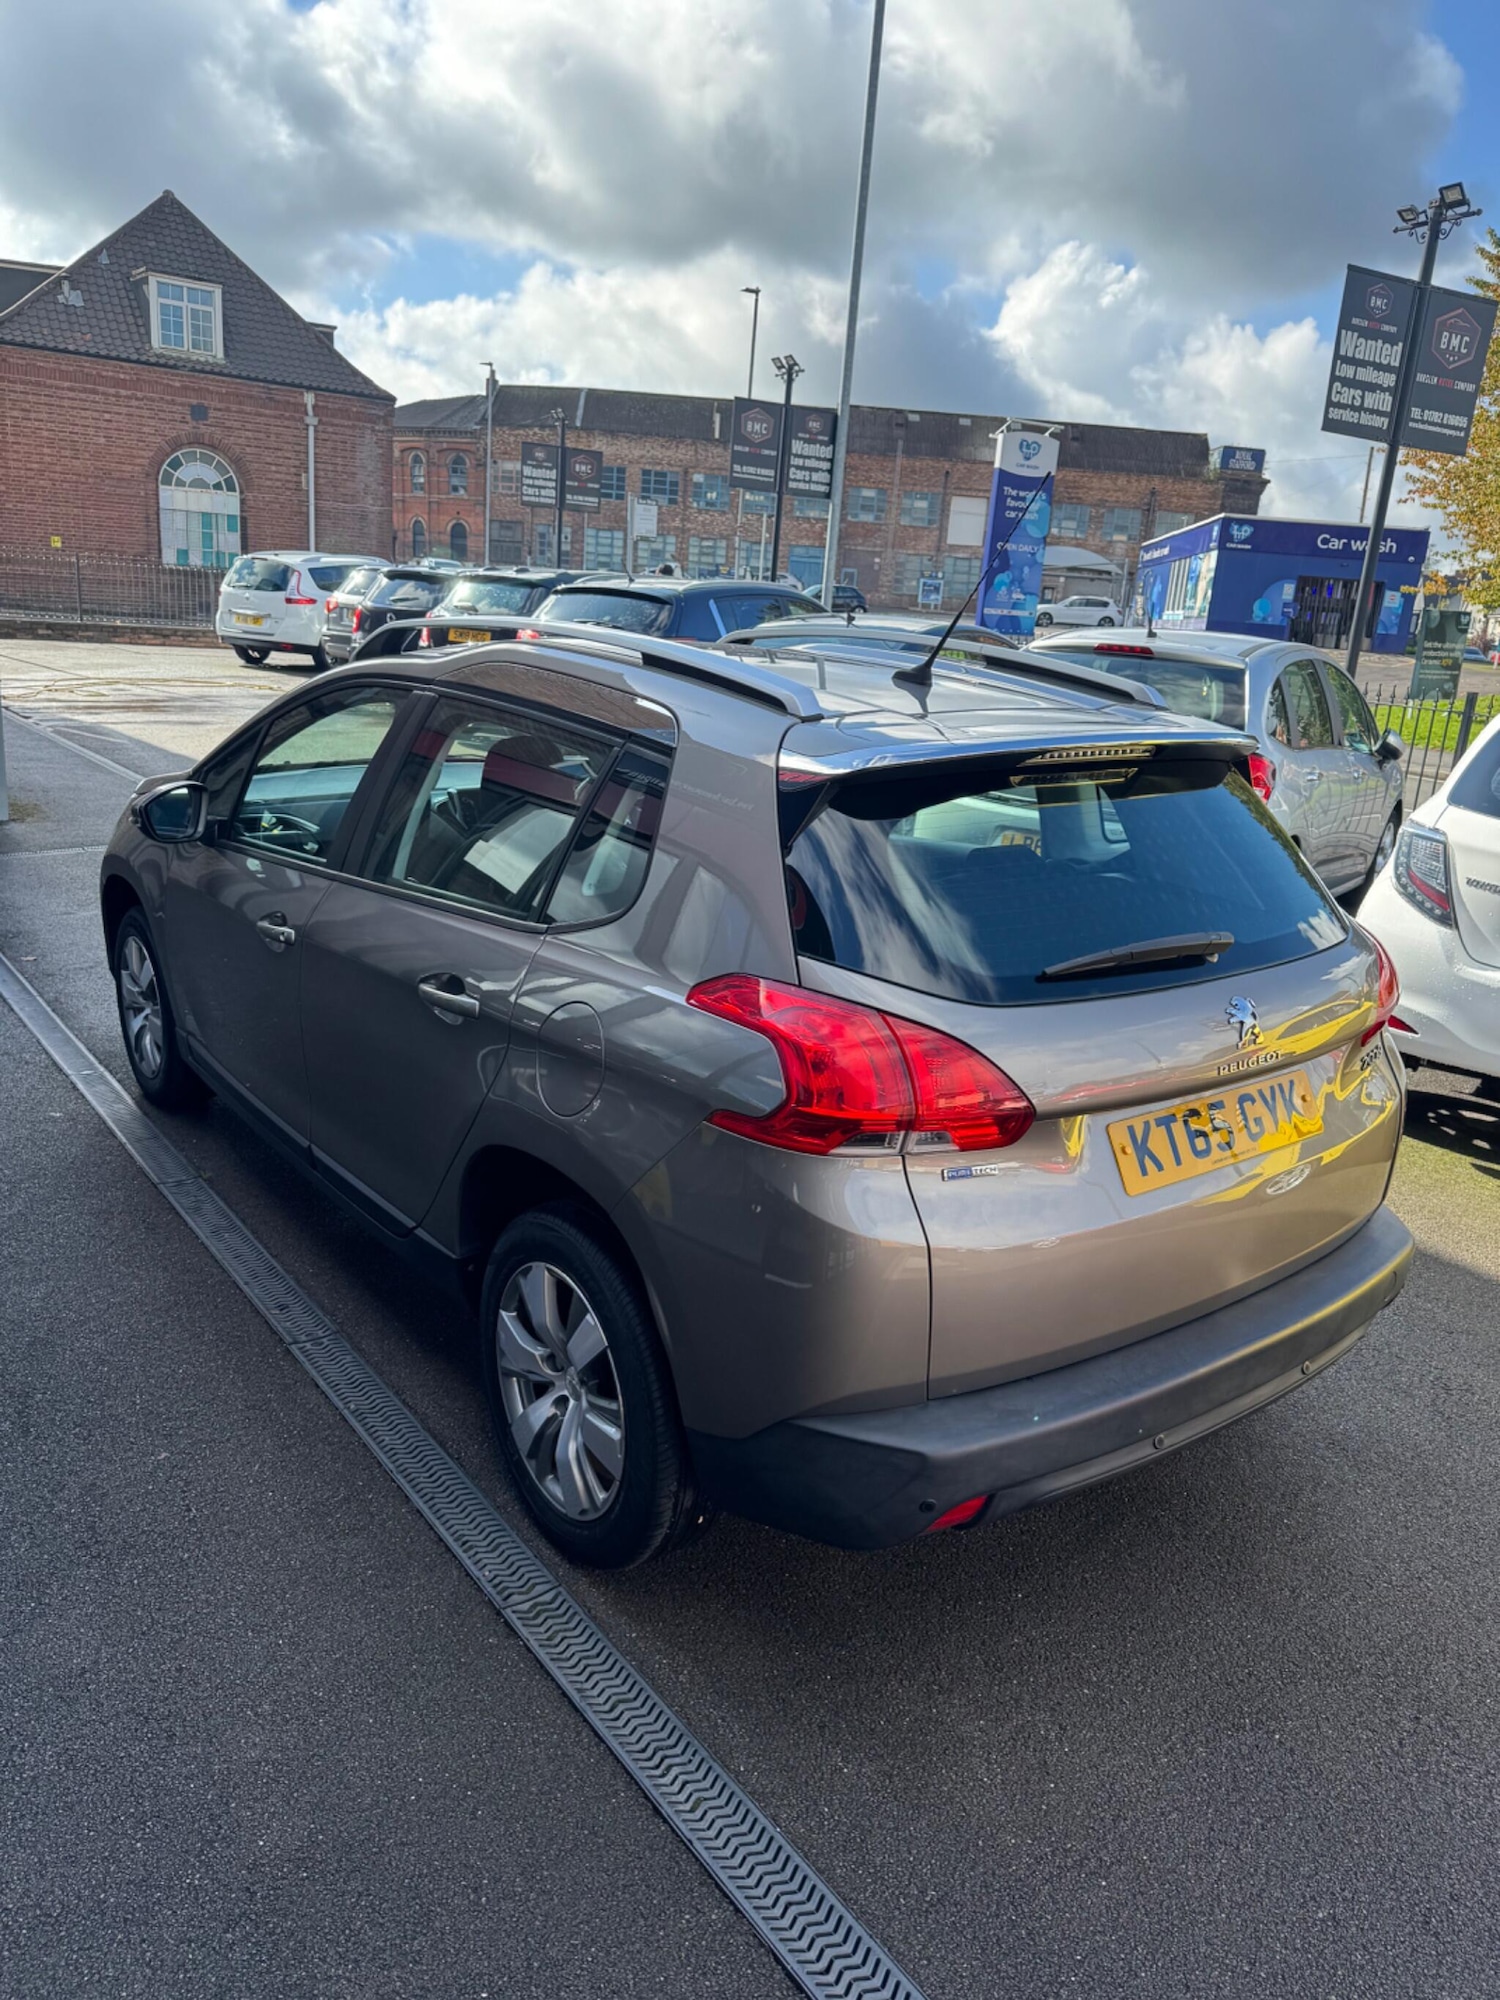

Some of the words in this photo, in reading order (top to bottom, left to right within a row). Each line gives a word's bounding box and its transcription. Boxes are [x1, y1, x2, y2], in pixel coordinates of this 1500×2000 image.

[1370, 295, 1389, 310] BMC
[1339, 329, 1404, 367] Wanted
[1440, 331, 1471, 354] BMC
[1335, 360, 1356, 379] Low
[1355, 366, 1397, 388] mileage
[1331, 381, 1363, 406] Cars
[1363, 390, 1393, 412] with
[746, 420, 768, 435] BMC
[1328, 407, 1360, 424] service
[1359, 410, 1390, 430] history
[791, 438, 834, 459] Wanted
[522, 465, 557, 480] Wanted
[804, 458, 831, 470] mileage
[789, 467, 810, 481] Cars
[810, 470, 831, 484] with
[1003, 486, 1018, 498] The
[1005, 510, 1018, 518] car
[996, 542, 1017, 552] OEN
[1018, 544, 1039, 553] DAILY
[1317, 533, 1348, 550] Car
[1350, 538, 1397, 554] wsh
[1216, 1049, 1281, 1076] PEUGEOT
[1126, 1100, 1235, 1177] KT65
[1236, 1079, 1299, 1143] GYK
